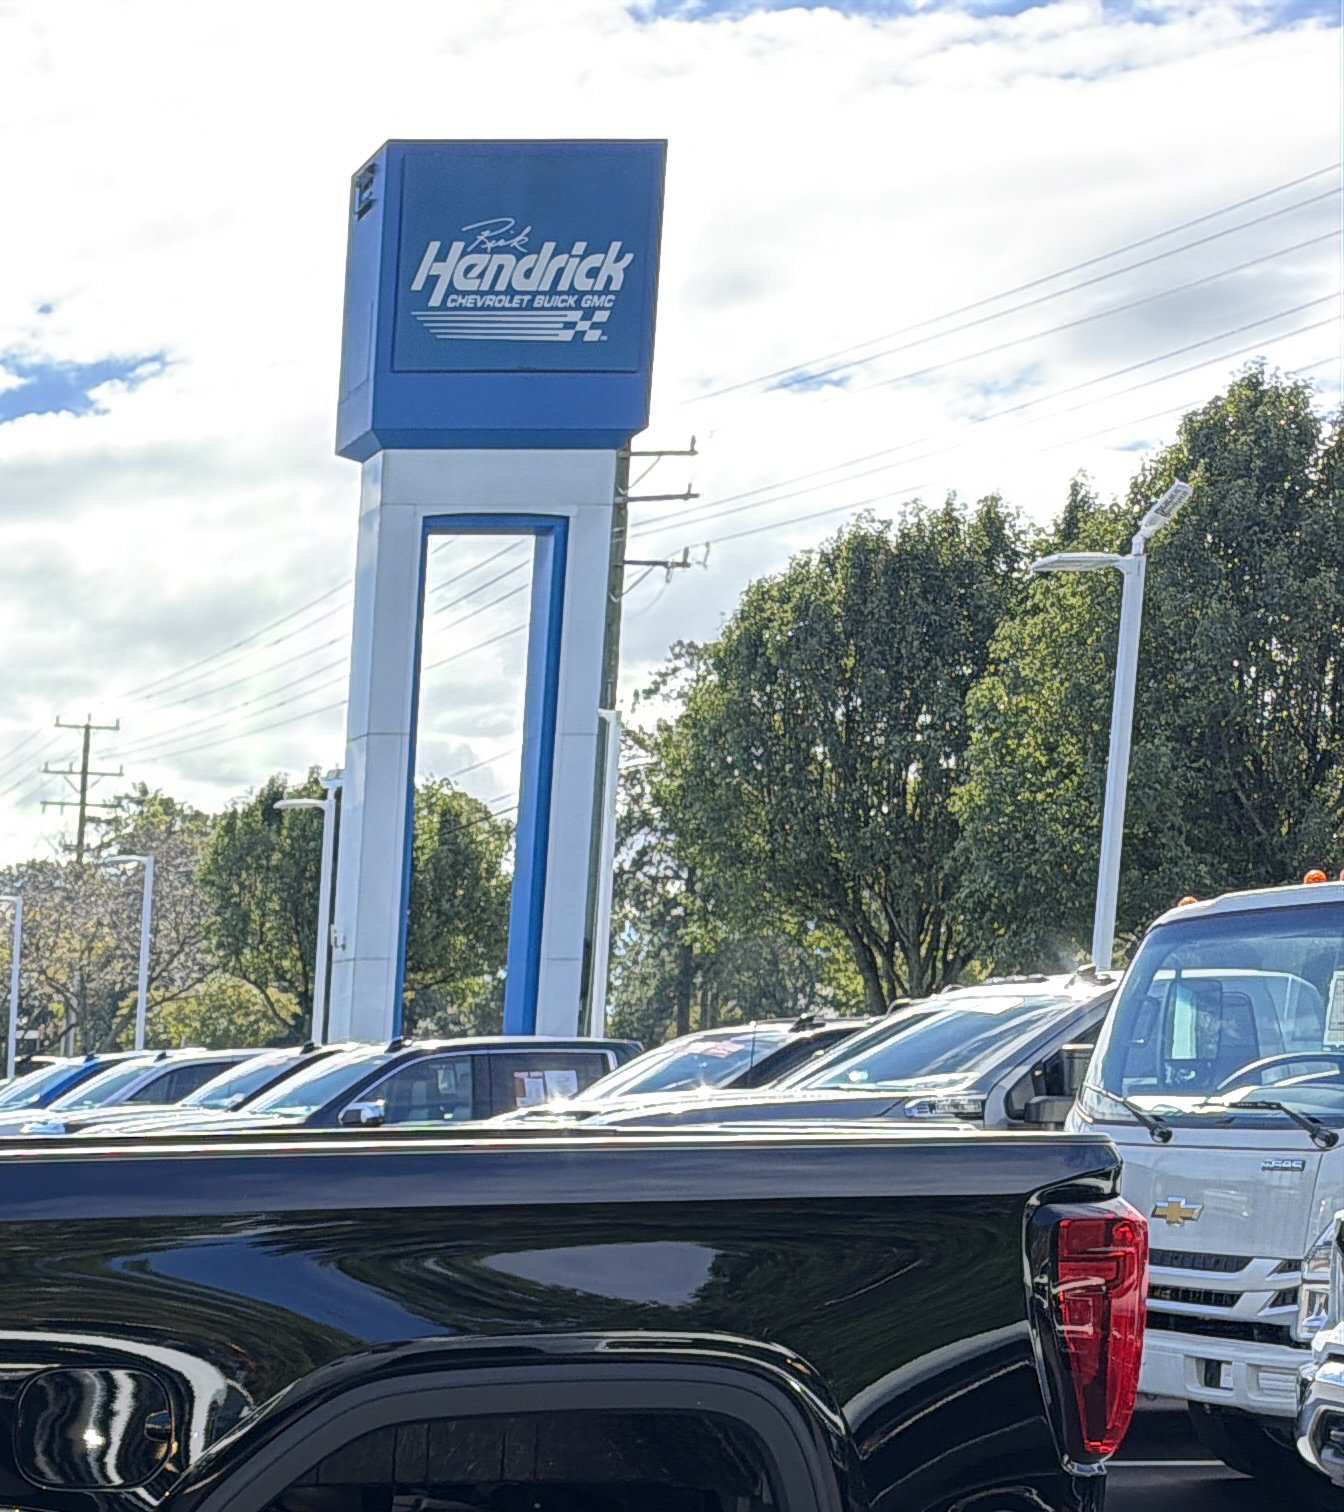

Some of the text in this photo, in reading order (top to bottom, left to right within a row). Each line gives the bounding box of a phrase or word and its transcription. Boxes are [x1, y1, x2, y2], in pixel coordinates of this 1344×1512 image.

[462, 217, 532, 253] Rick
[410, 240, 634, 308] Hendrick
[446, 294, 616, 309] CHEVROLET BUICK GMC
